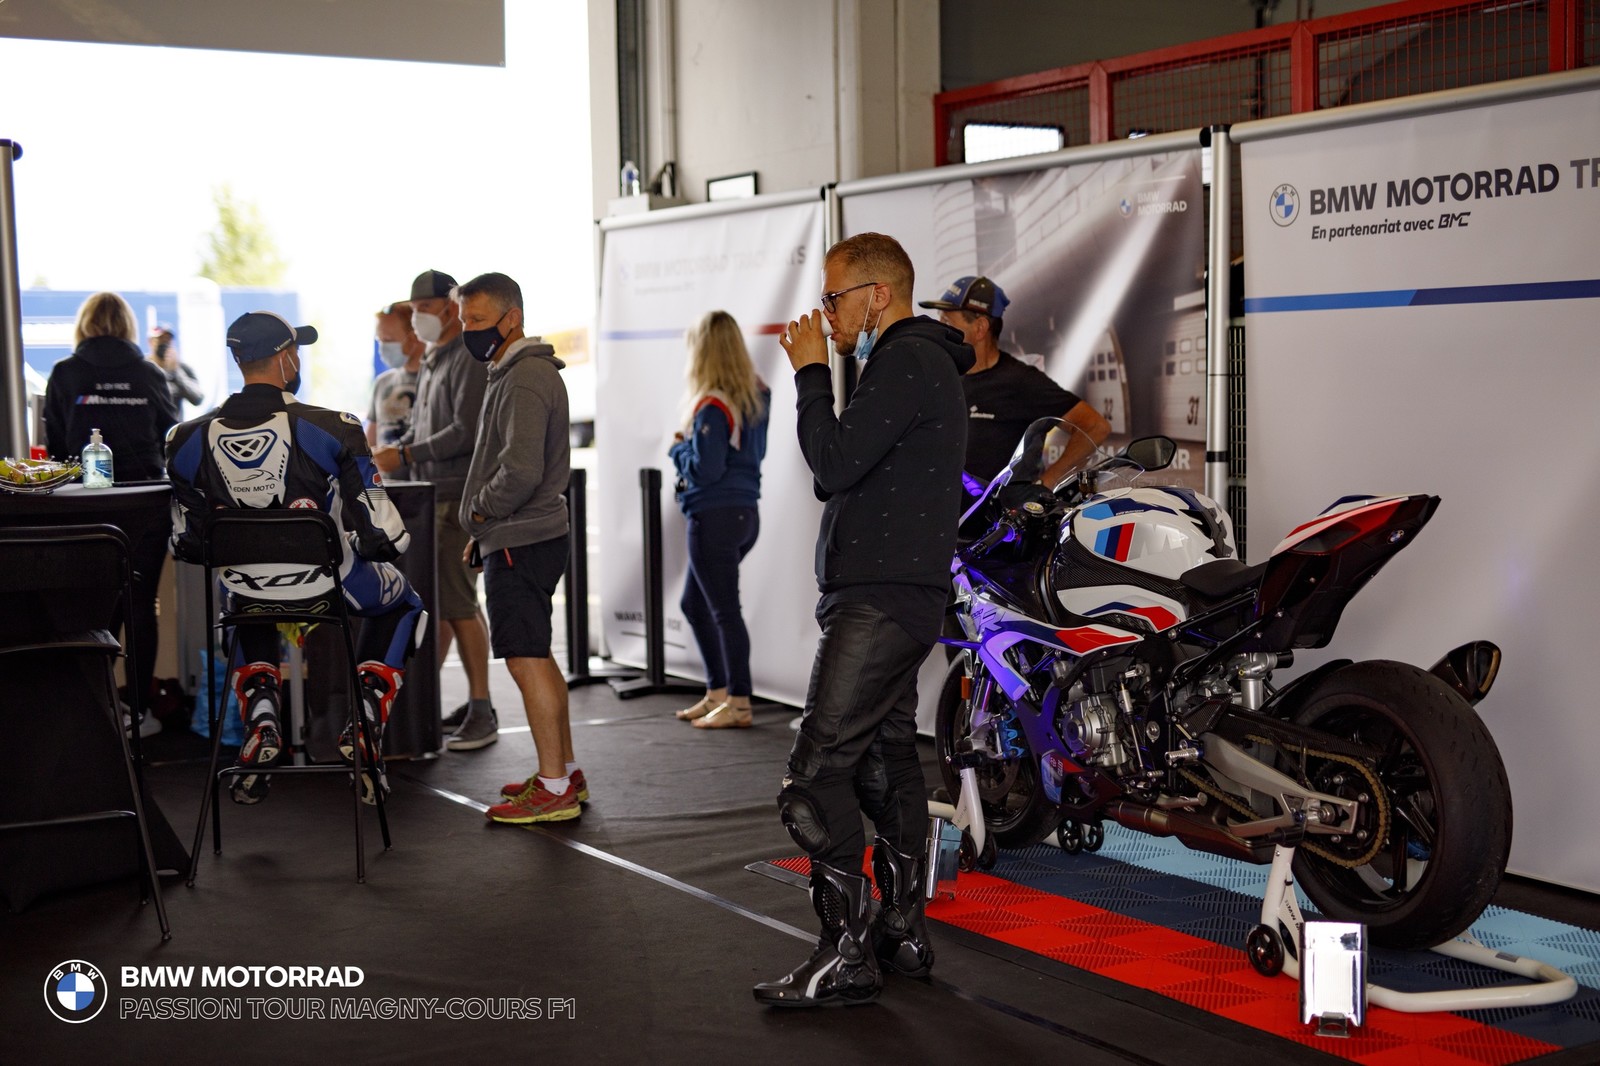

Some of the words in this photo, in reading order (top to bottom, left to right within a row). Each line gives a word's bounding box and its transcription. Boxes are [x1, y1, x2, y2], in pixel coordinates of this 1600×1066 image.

[1310, 182, 1378, 216] BMW
[1386, 162, 1560, 209] MOTORRAD
[1137, 200, 1188, 217] MOTORRAD
[1310, 225, 1327, 240] En
[1328, 219, 1402, 242] partenariat
[1403, 219, 1435, 233] avec
[1187, 394, 1200, 426] 31
[253, 483, 276, 492] MOTO
